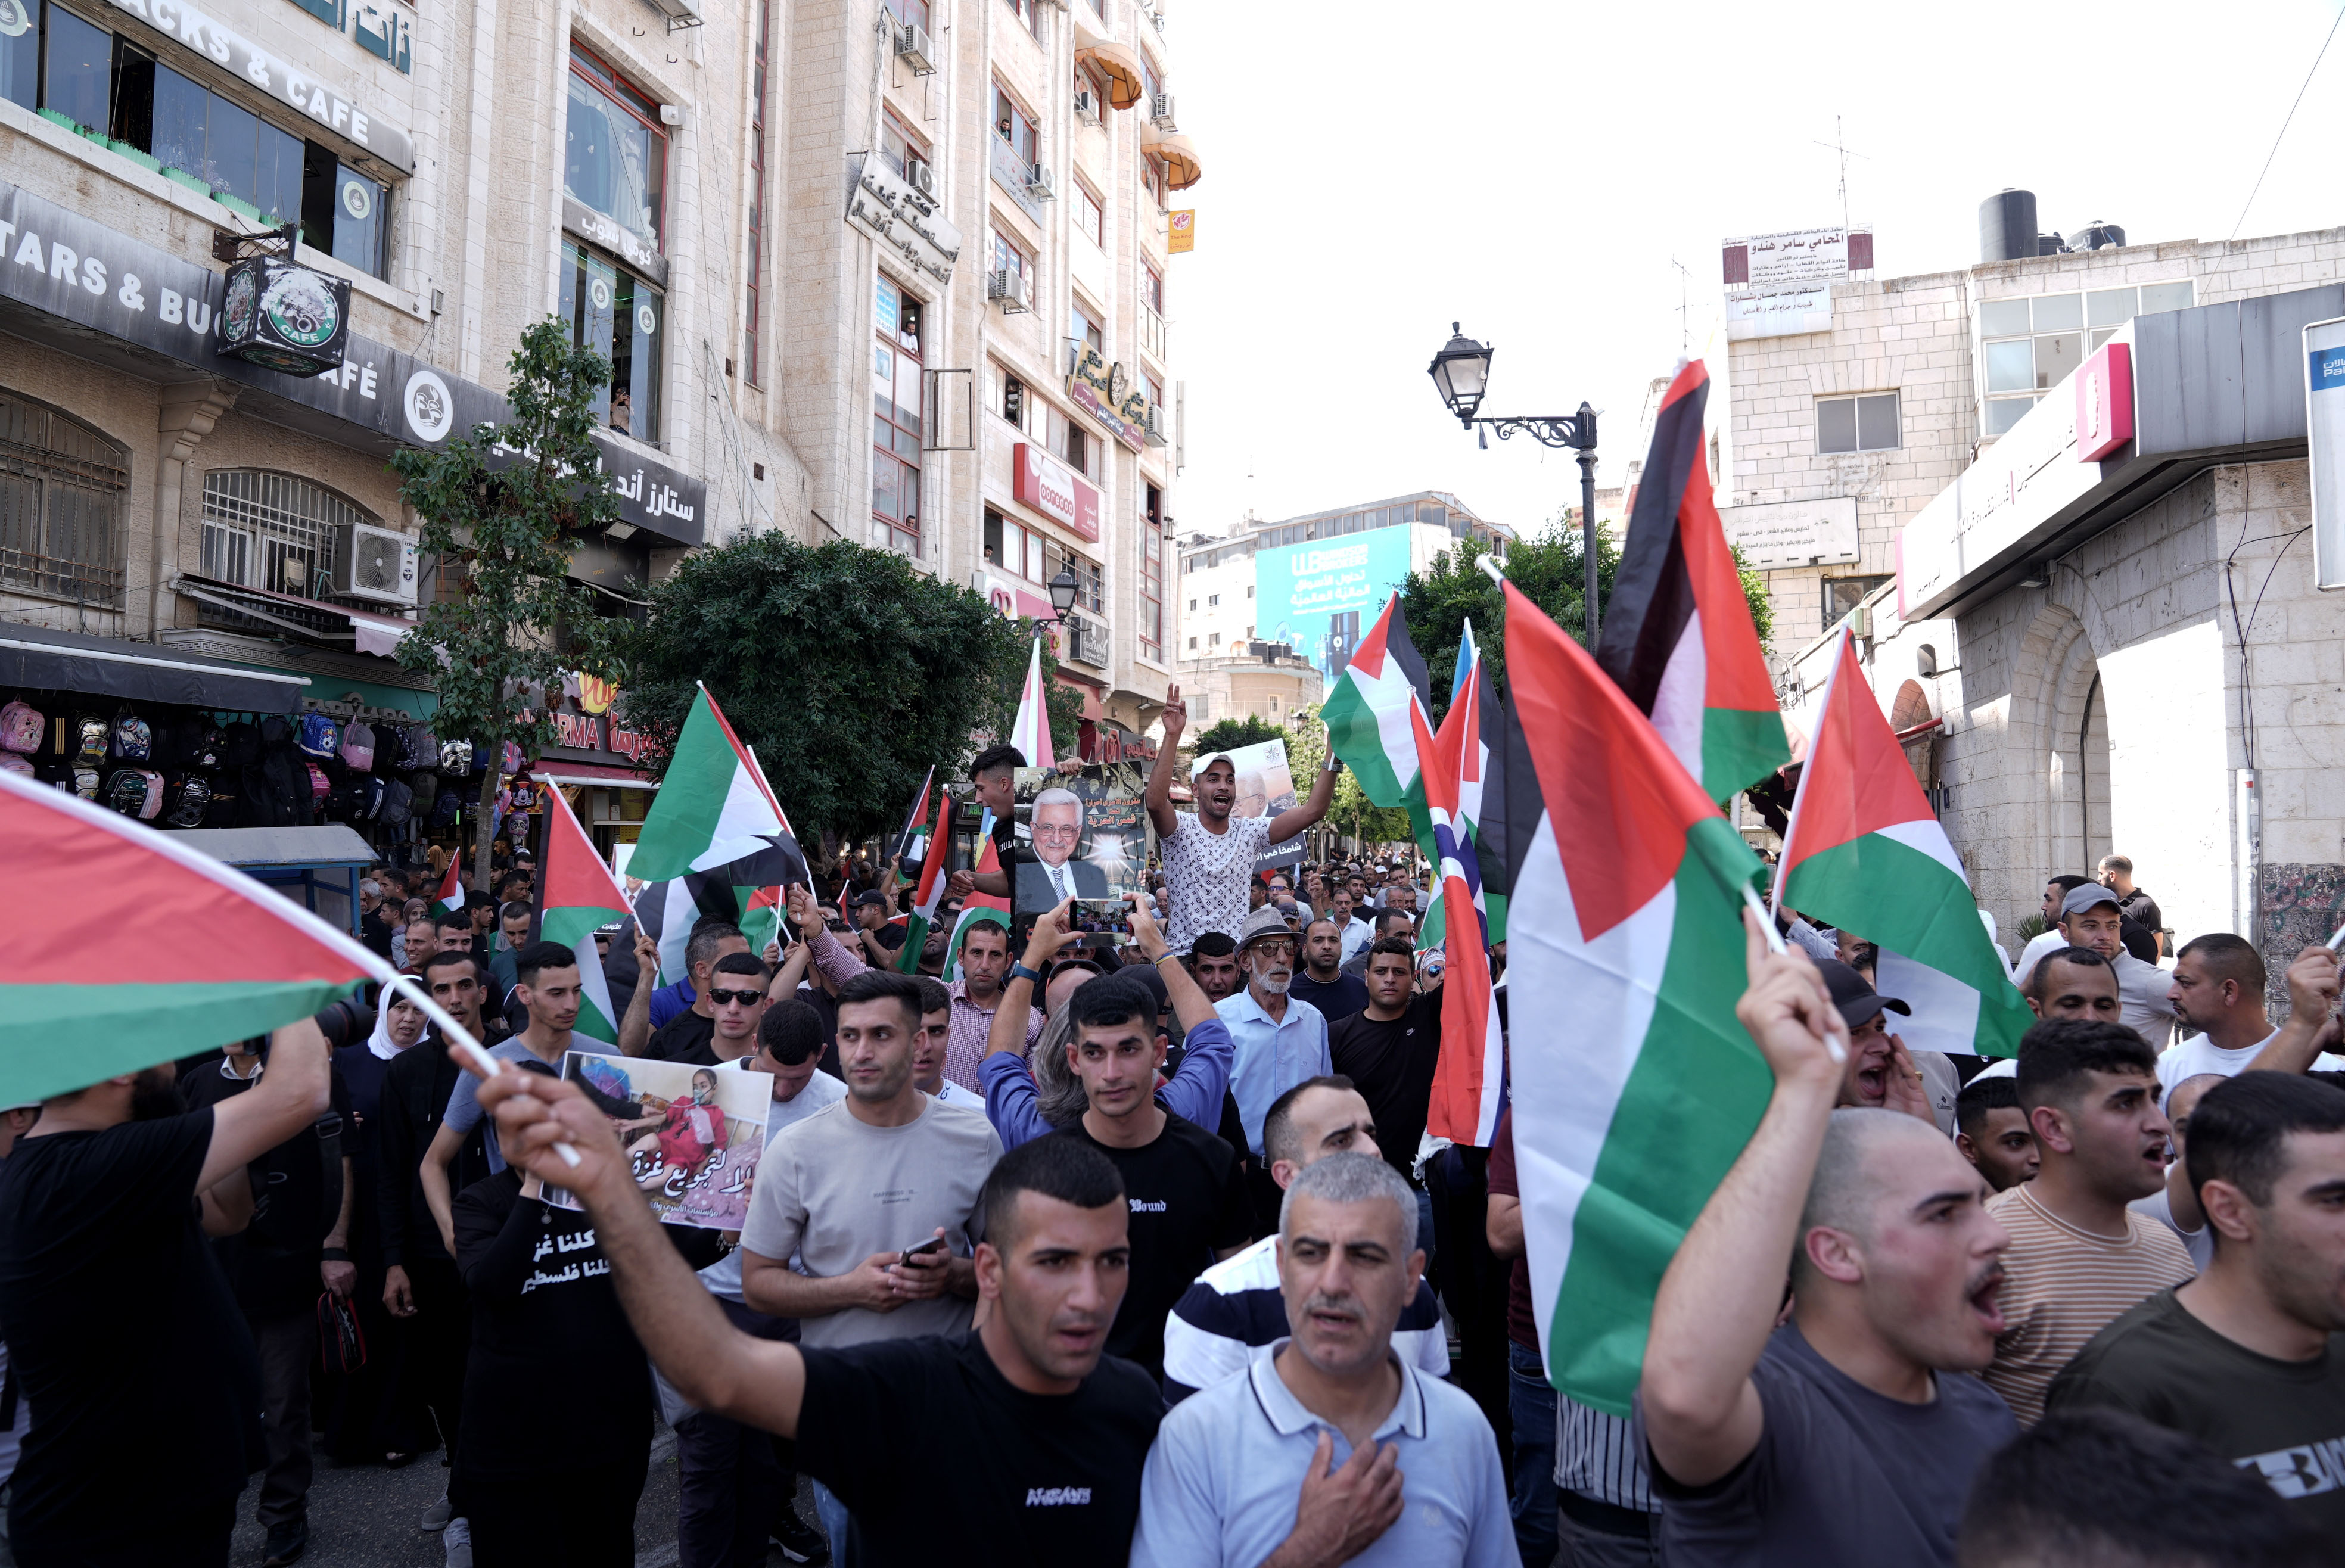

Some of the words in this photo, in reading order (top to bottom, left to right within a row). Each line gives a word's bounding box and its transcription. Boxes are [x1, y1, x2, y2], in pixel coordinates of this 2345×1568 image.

[286, 75, 368, 144] CAFE
[1780, 237, 1805, 251] سامر
[1809, 233, 1843, 251] المحامي
[1730, 293, 1756, 302] بشارات
[1758, 292, 1778, 300] جمال
[119, 273, 145, 312] &
[318, 362, 377, 400] AFÉ
[281, 325, 320, 343] CAFE
[646, 483, 694, 522] ستارز
[1041, 483, 1074, 517] ooredoo
[1088, 815, 1115, 828] الحرية
[1116, 813, 1136, 826] شمس
[1263, 850, 1279, 860] في
[632, 1150, 665, 1183] غزة
[664, 1150, 727, 1197] لتجويع
[719, 1165, 752, 1194] لا
[664, 1203, 687, 1212] الأسرى
[688, 1206, 719, 1217] مؤسسات
[557, 1228, 595, 1253] كلنا
